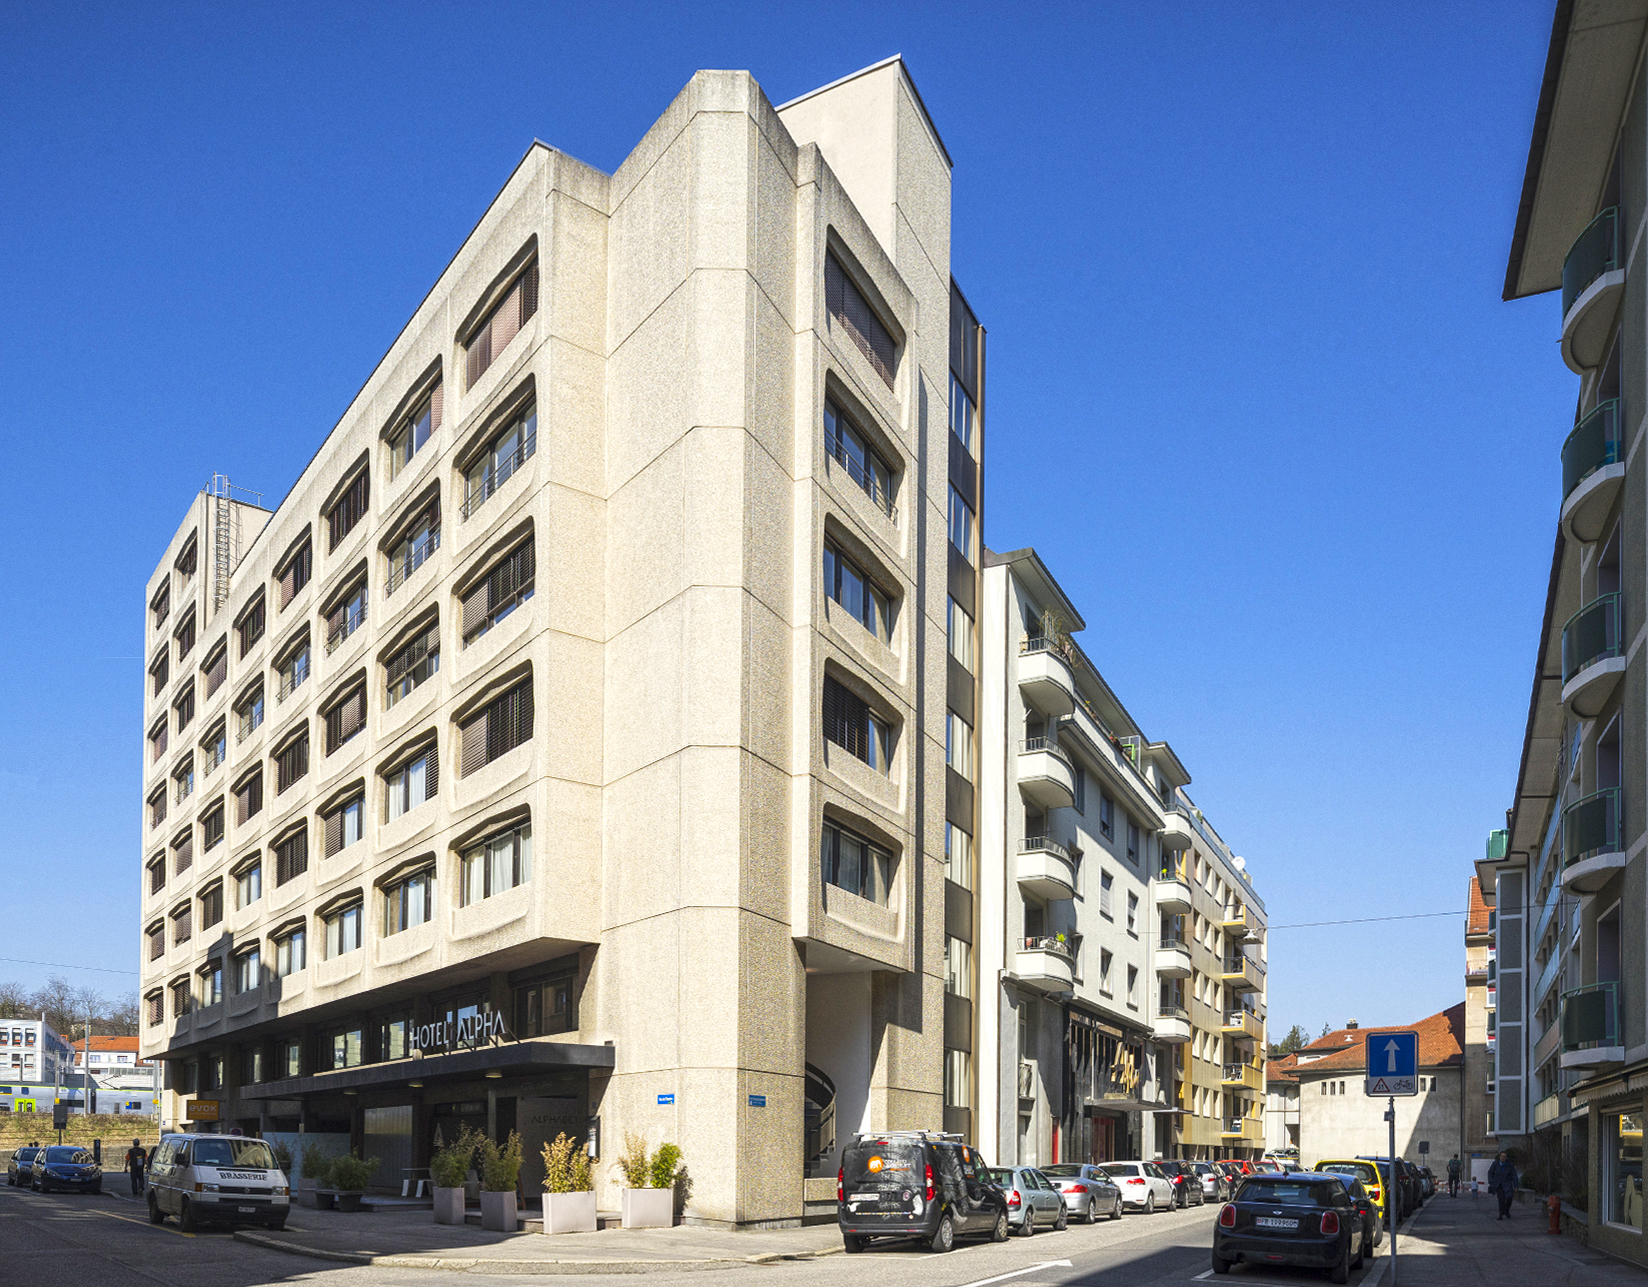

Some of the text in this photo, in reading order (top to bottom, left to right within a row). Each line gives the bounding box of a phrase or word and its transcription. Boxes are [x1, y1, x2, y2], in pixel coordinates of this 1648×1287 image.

[411, 1009, 506, 1050] HOTEL ALPHA
[530, 1115, 578, 1124] ALPHABET
[219, 1172, 267, 1181] BRASSERIE
